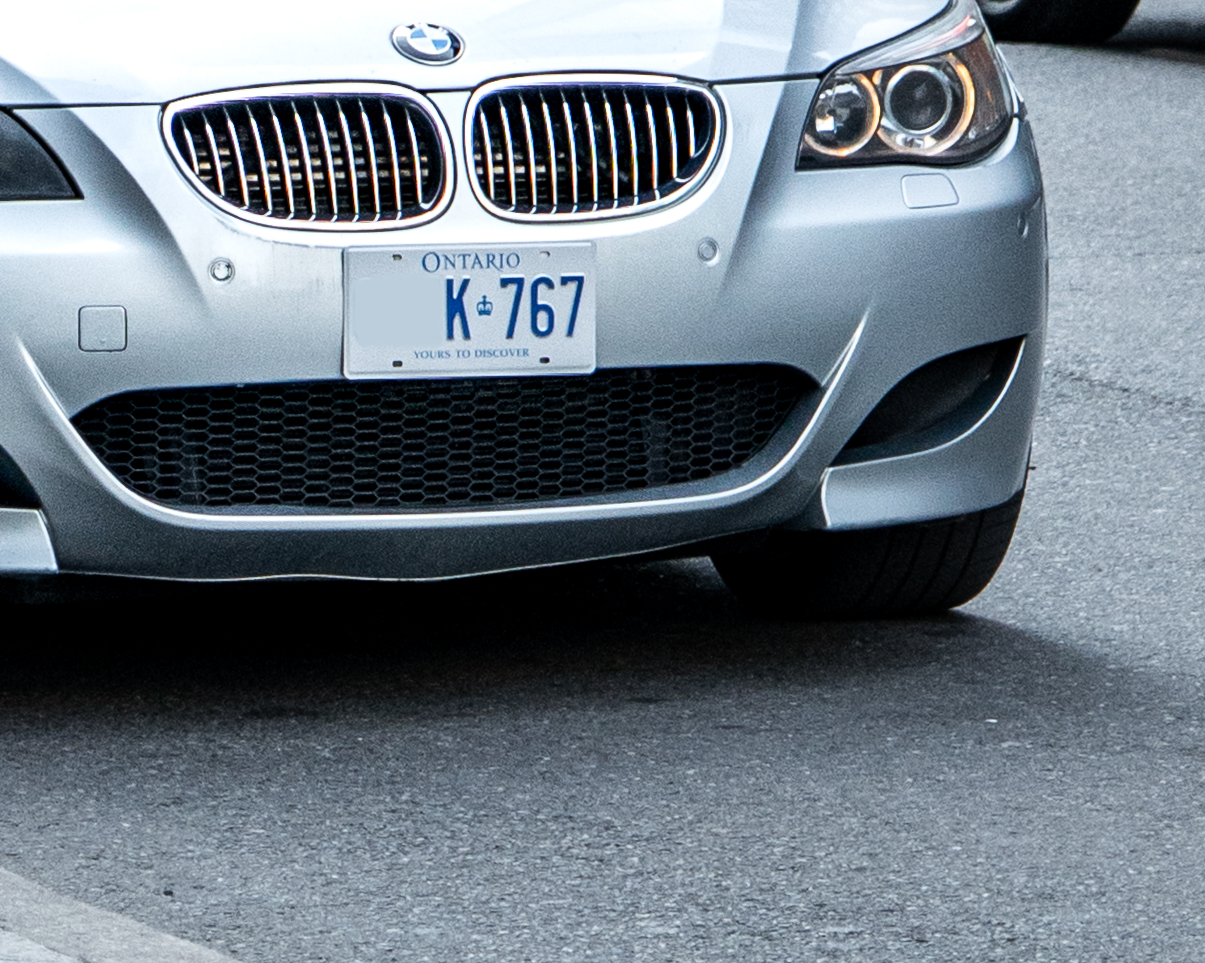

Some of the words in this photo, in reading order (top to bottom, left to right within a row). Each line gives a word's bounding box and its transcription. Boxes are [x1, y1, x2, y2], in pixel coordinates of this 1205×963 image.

[421, 251, 521, 273] ONTARIO
[499, 272, 585, 340] 767
[413, 349, 451, 360] YOURS
[456, 349, 471, 359] TO
[474, 348, 530, 358] DISCOVER
